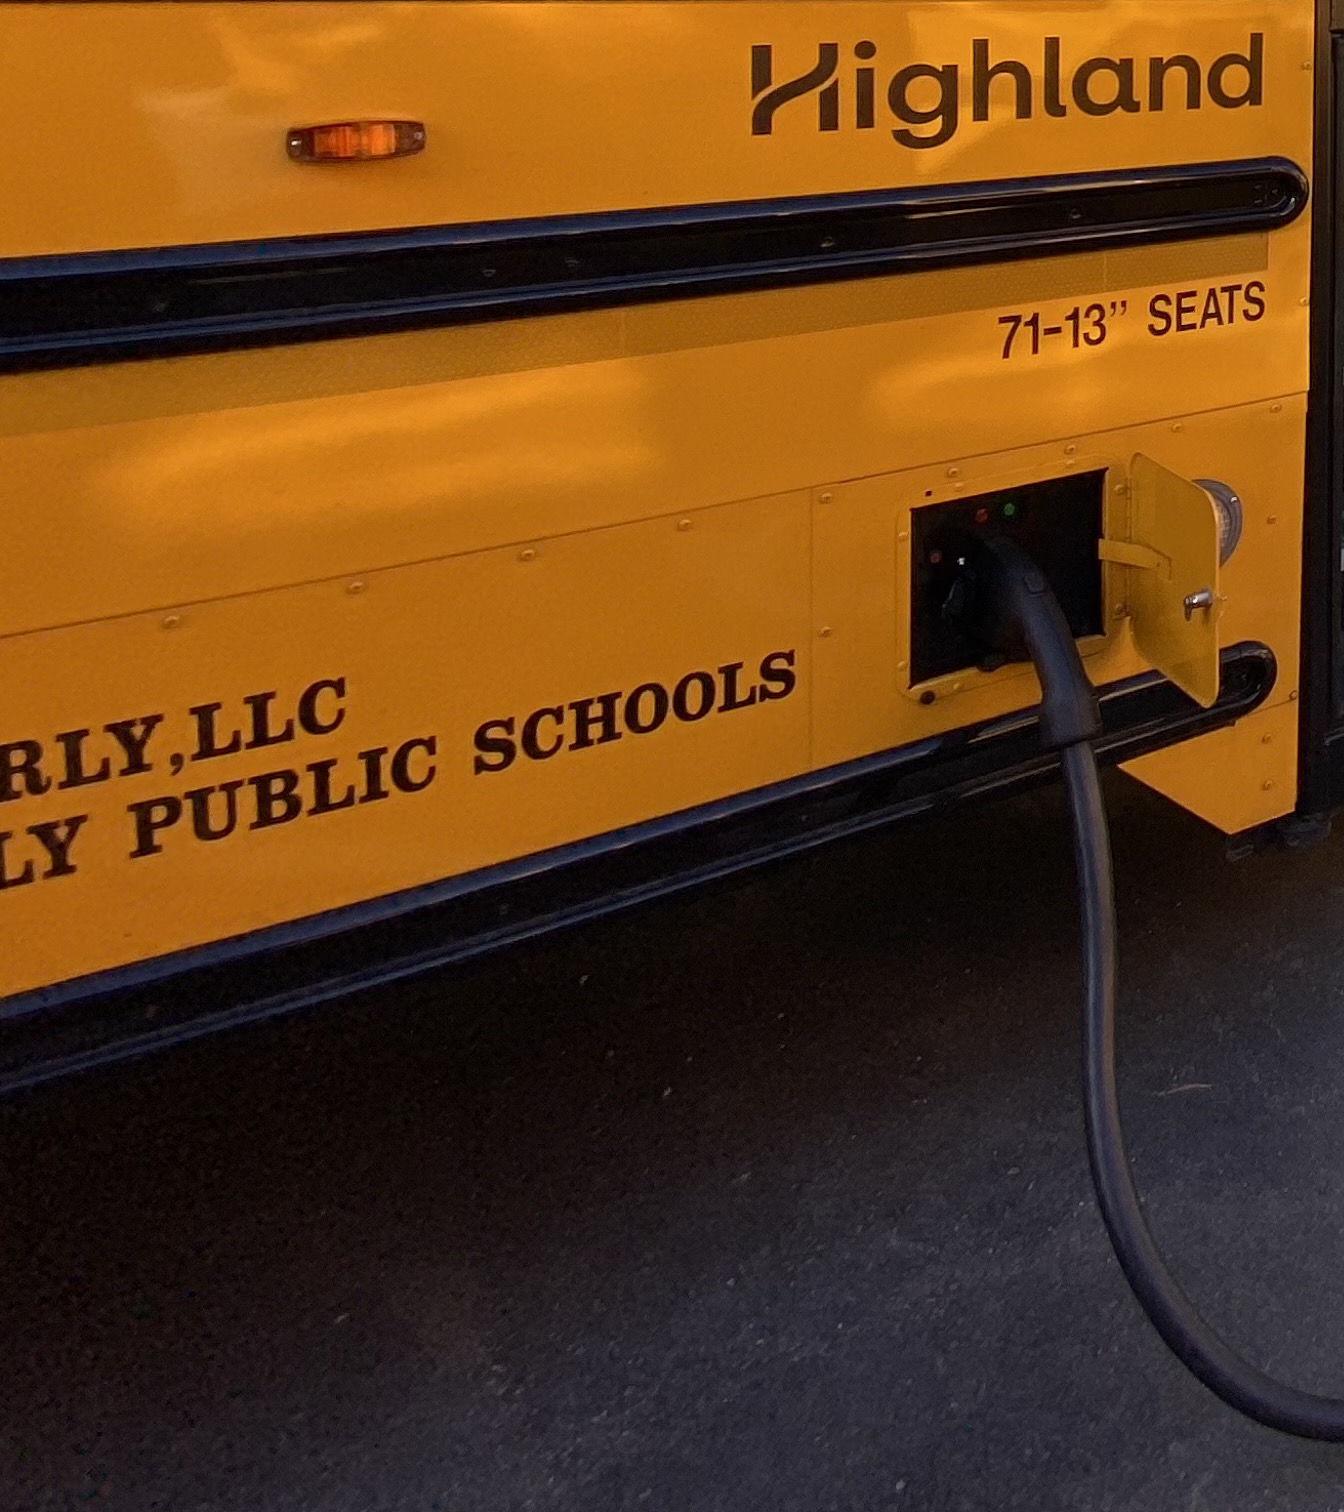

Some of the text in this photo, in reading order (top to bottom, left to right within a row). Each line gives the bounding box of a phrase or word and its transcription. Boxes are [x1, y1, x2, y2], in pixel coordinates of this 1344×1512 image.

[751, 33, 1264, 150] Highland
[1147, 279, 1266, 337] SEATS
[128, 735, 438, 860] PUBLIC
[473, 649, 798, 776] SCHOOLS
